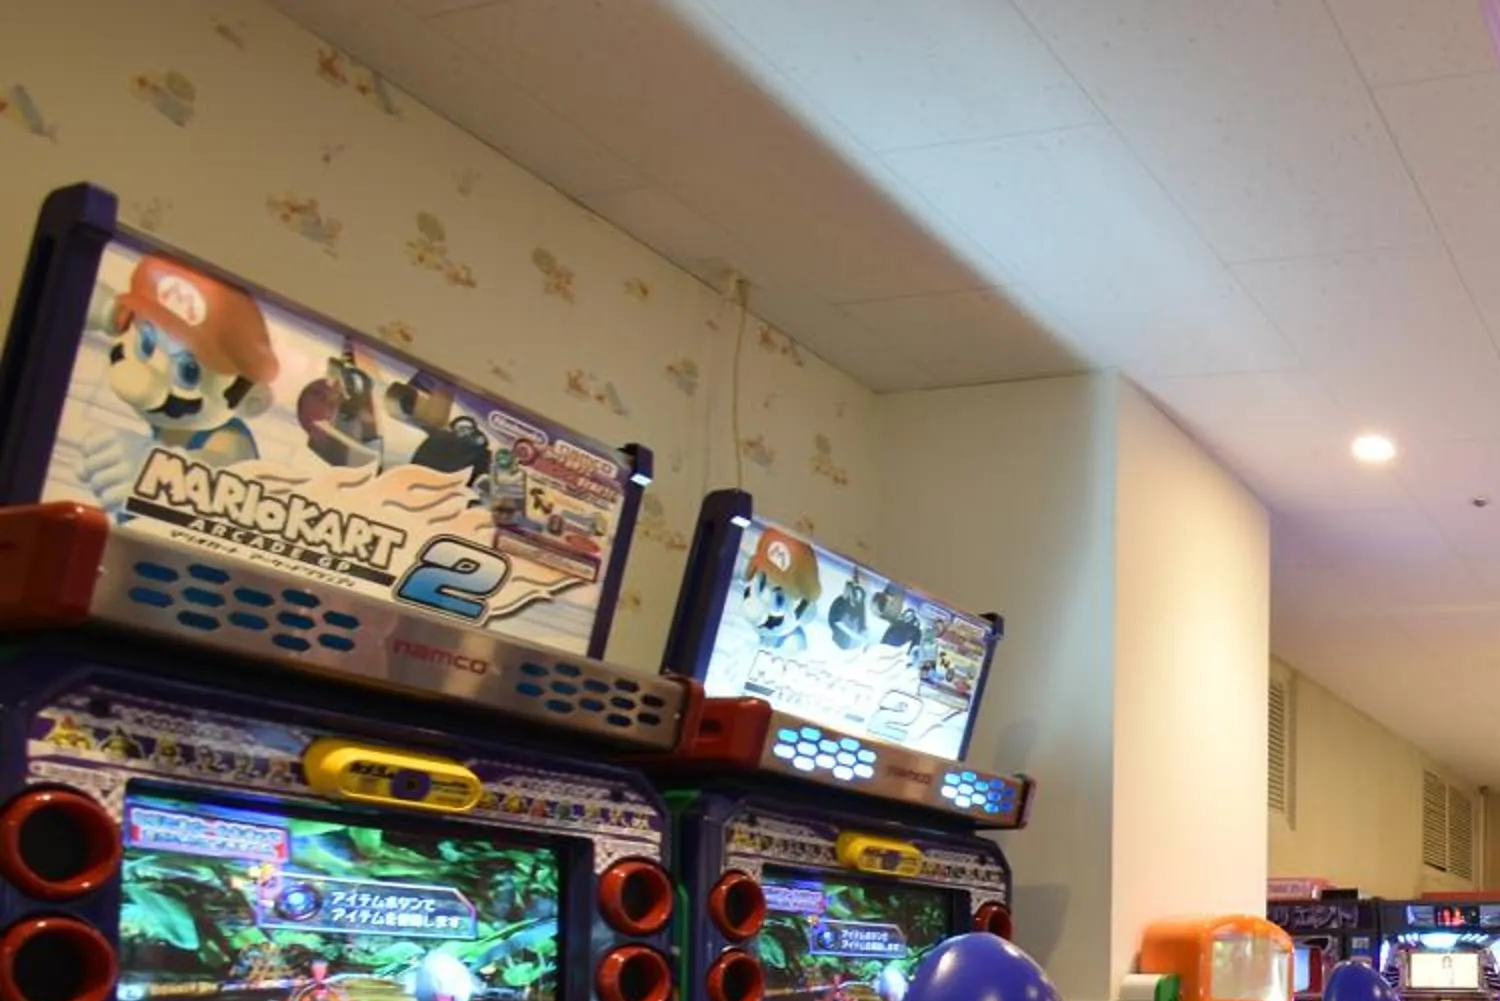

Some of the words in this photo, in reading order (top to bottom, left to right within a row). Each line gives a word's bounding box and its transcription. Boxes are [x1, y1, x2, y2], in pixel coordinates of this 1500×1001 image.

[189, 518, 304, 560] ARCADE
[318, 554, 352, 573] GP
[395, 536, 511, 624] 2
[394, 639, 488, 676] namco
